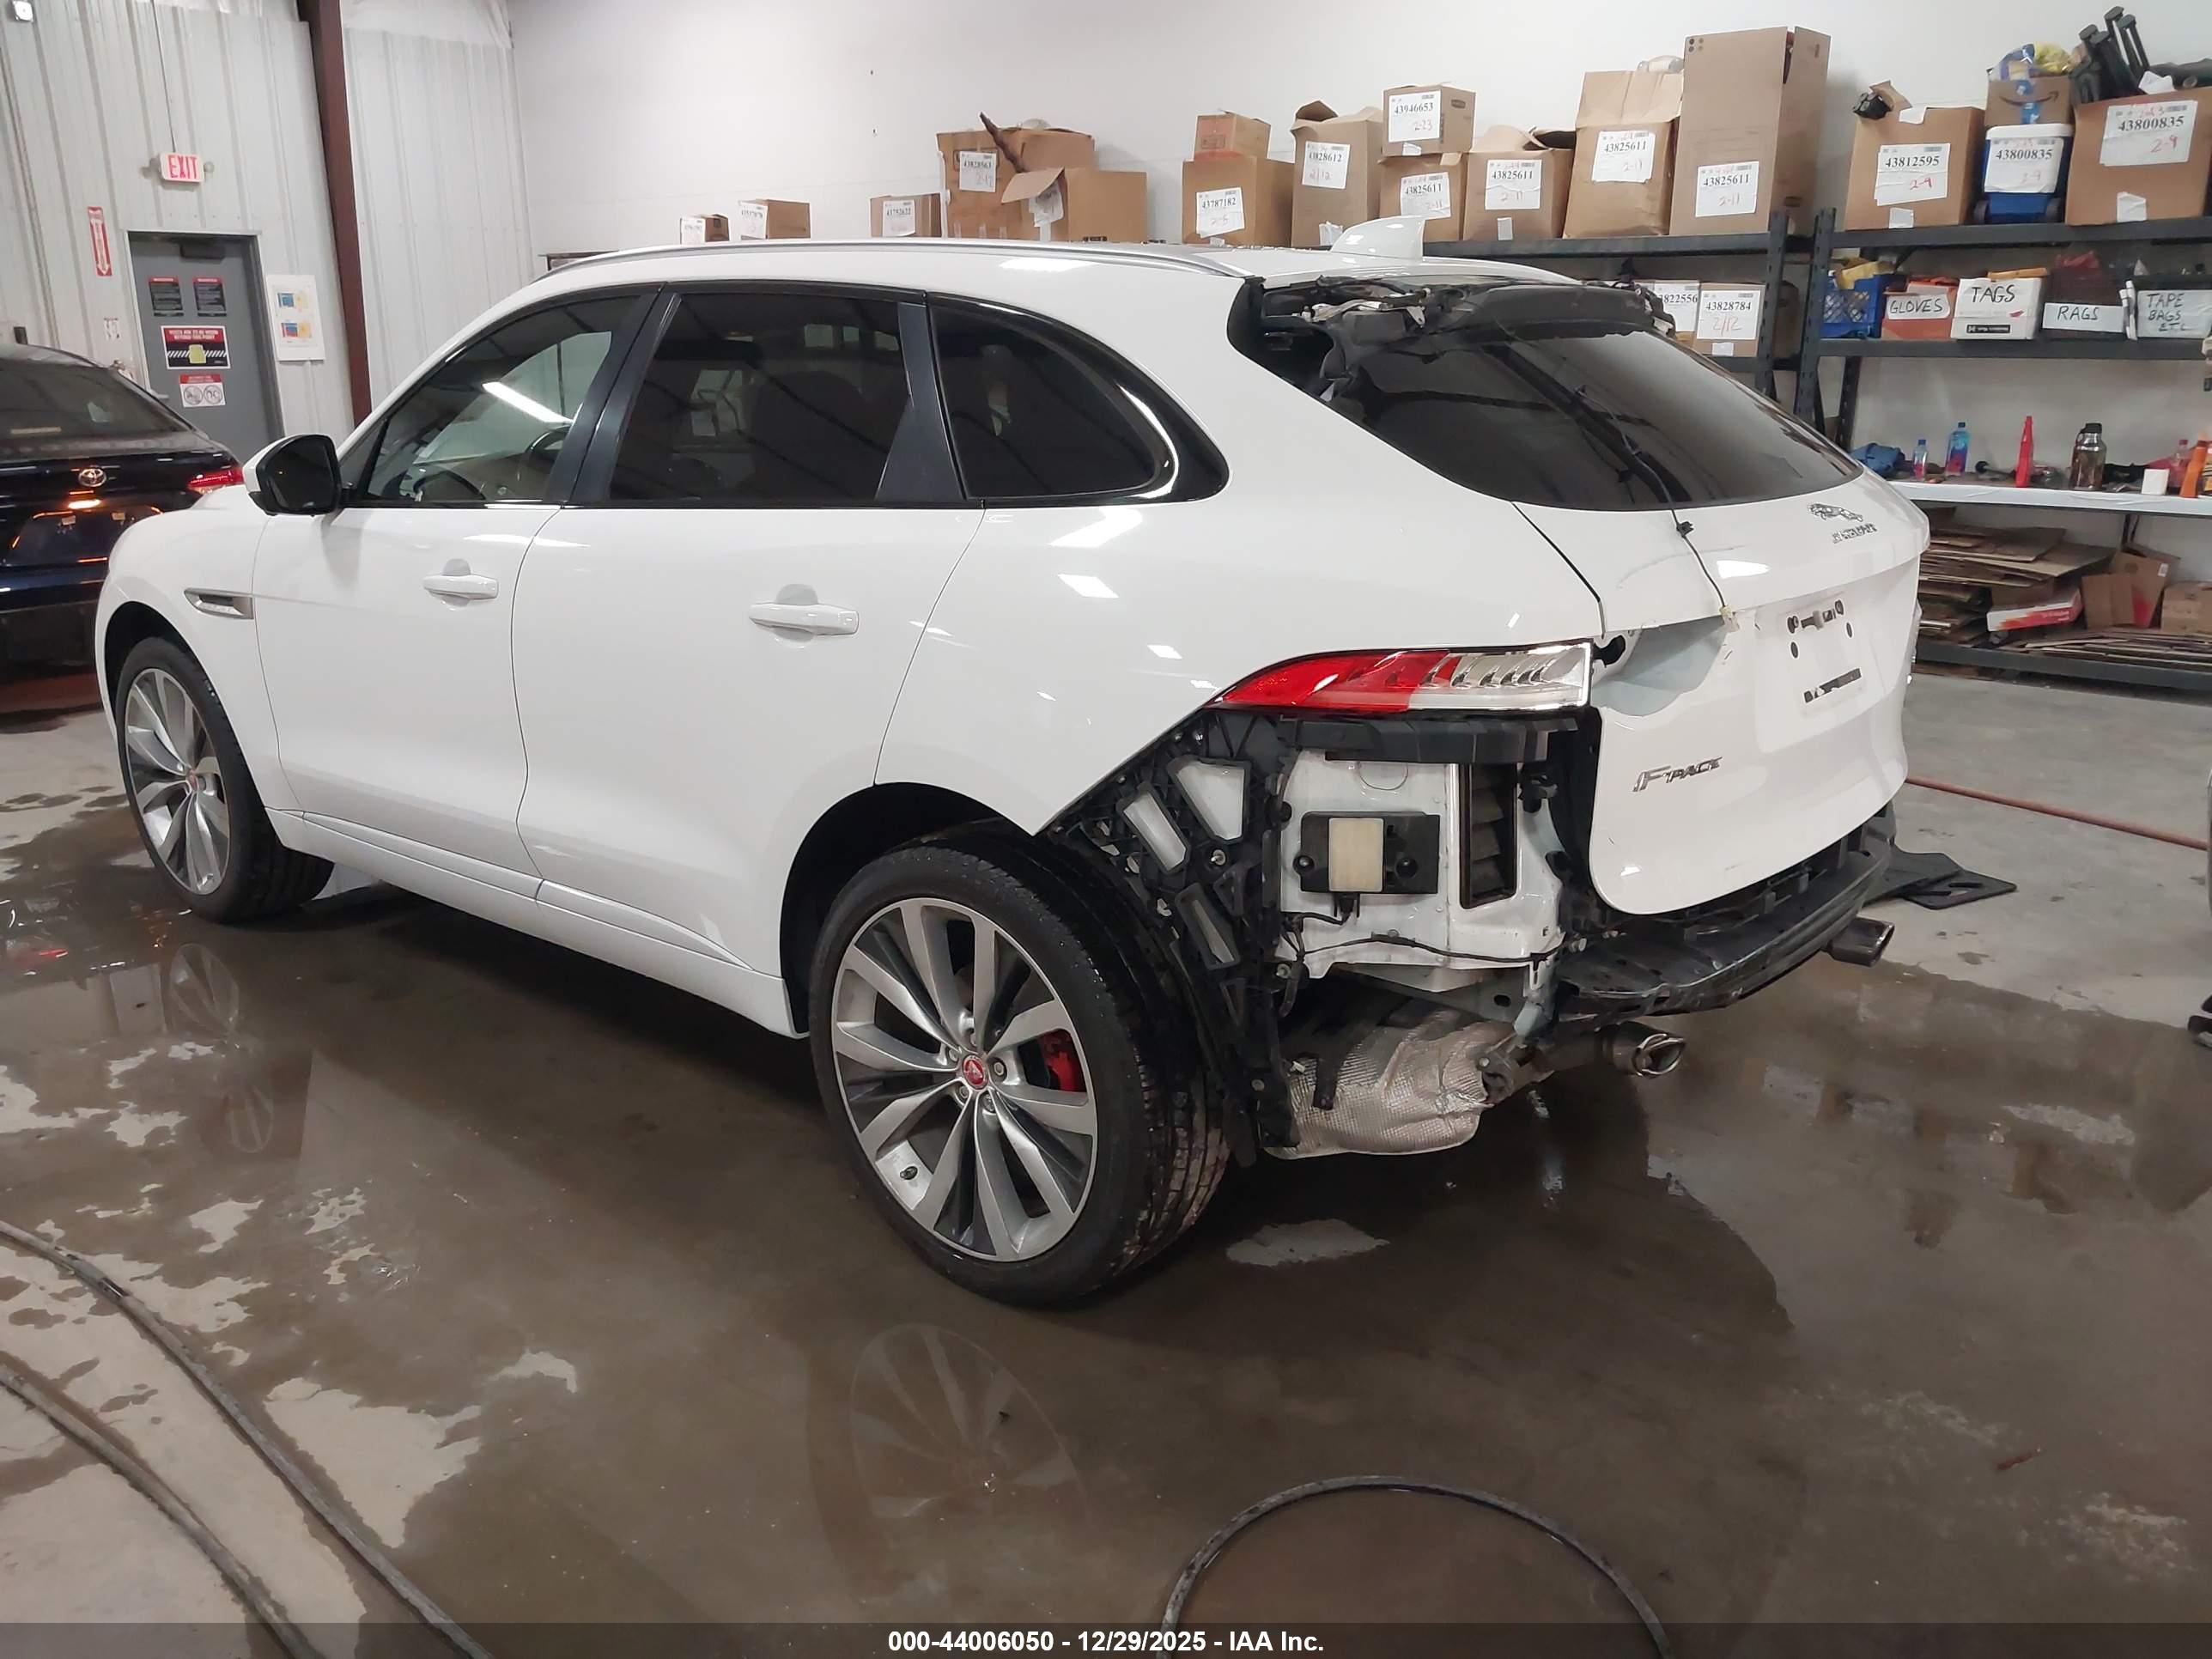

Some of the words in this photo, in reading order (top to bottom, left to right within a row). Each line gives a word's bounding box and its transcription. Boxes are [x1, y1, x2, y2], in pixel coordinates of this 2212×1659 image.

[1395, 102, 1434, 113] 43946653
[2118, 115, 2185, 131] 43800835
[1604, 140, 1646, 153] 43825611
[2150, 134, 2179, 153] 2-9
[1885, 155, 1941, 167] 43812595
[1995, 149, 2053, 161] 43800835
[167, 155, 198, 179] EXIT
[1492, 170, 1533, 179] 43825611
[1703, 173, 1749, 187] 43825611
[1405, 182, 1442, 195] 43825611
[1910, 176, 1933, 191] 2-9
[1202, 197, 1237, 209] 43787182
[1972, 284, 2015, 303] TAGS
[1705, 301, 1752, 311] 43828784
[1890, 298, 1944, 314] GLOVES
[2147, 293, 2185, 308] TAPE
[2057, 305, 2100, 321] RAGS
[2148, 310, 2183, 322] BAGS
